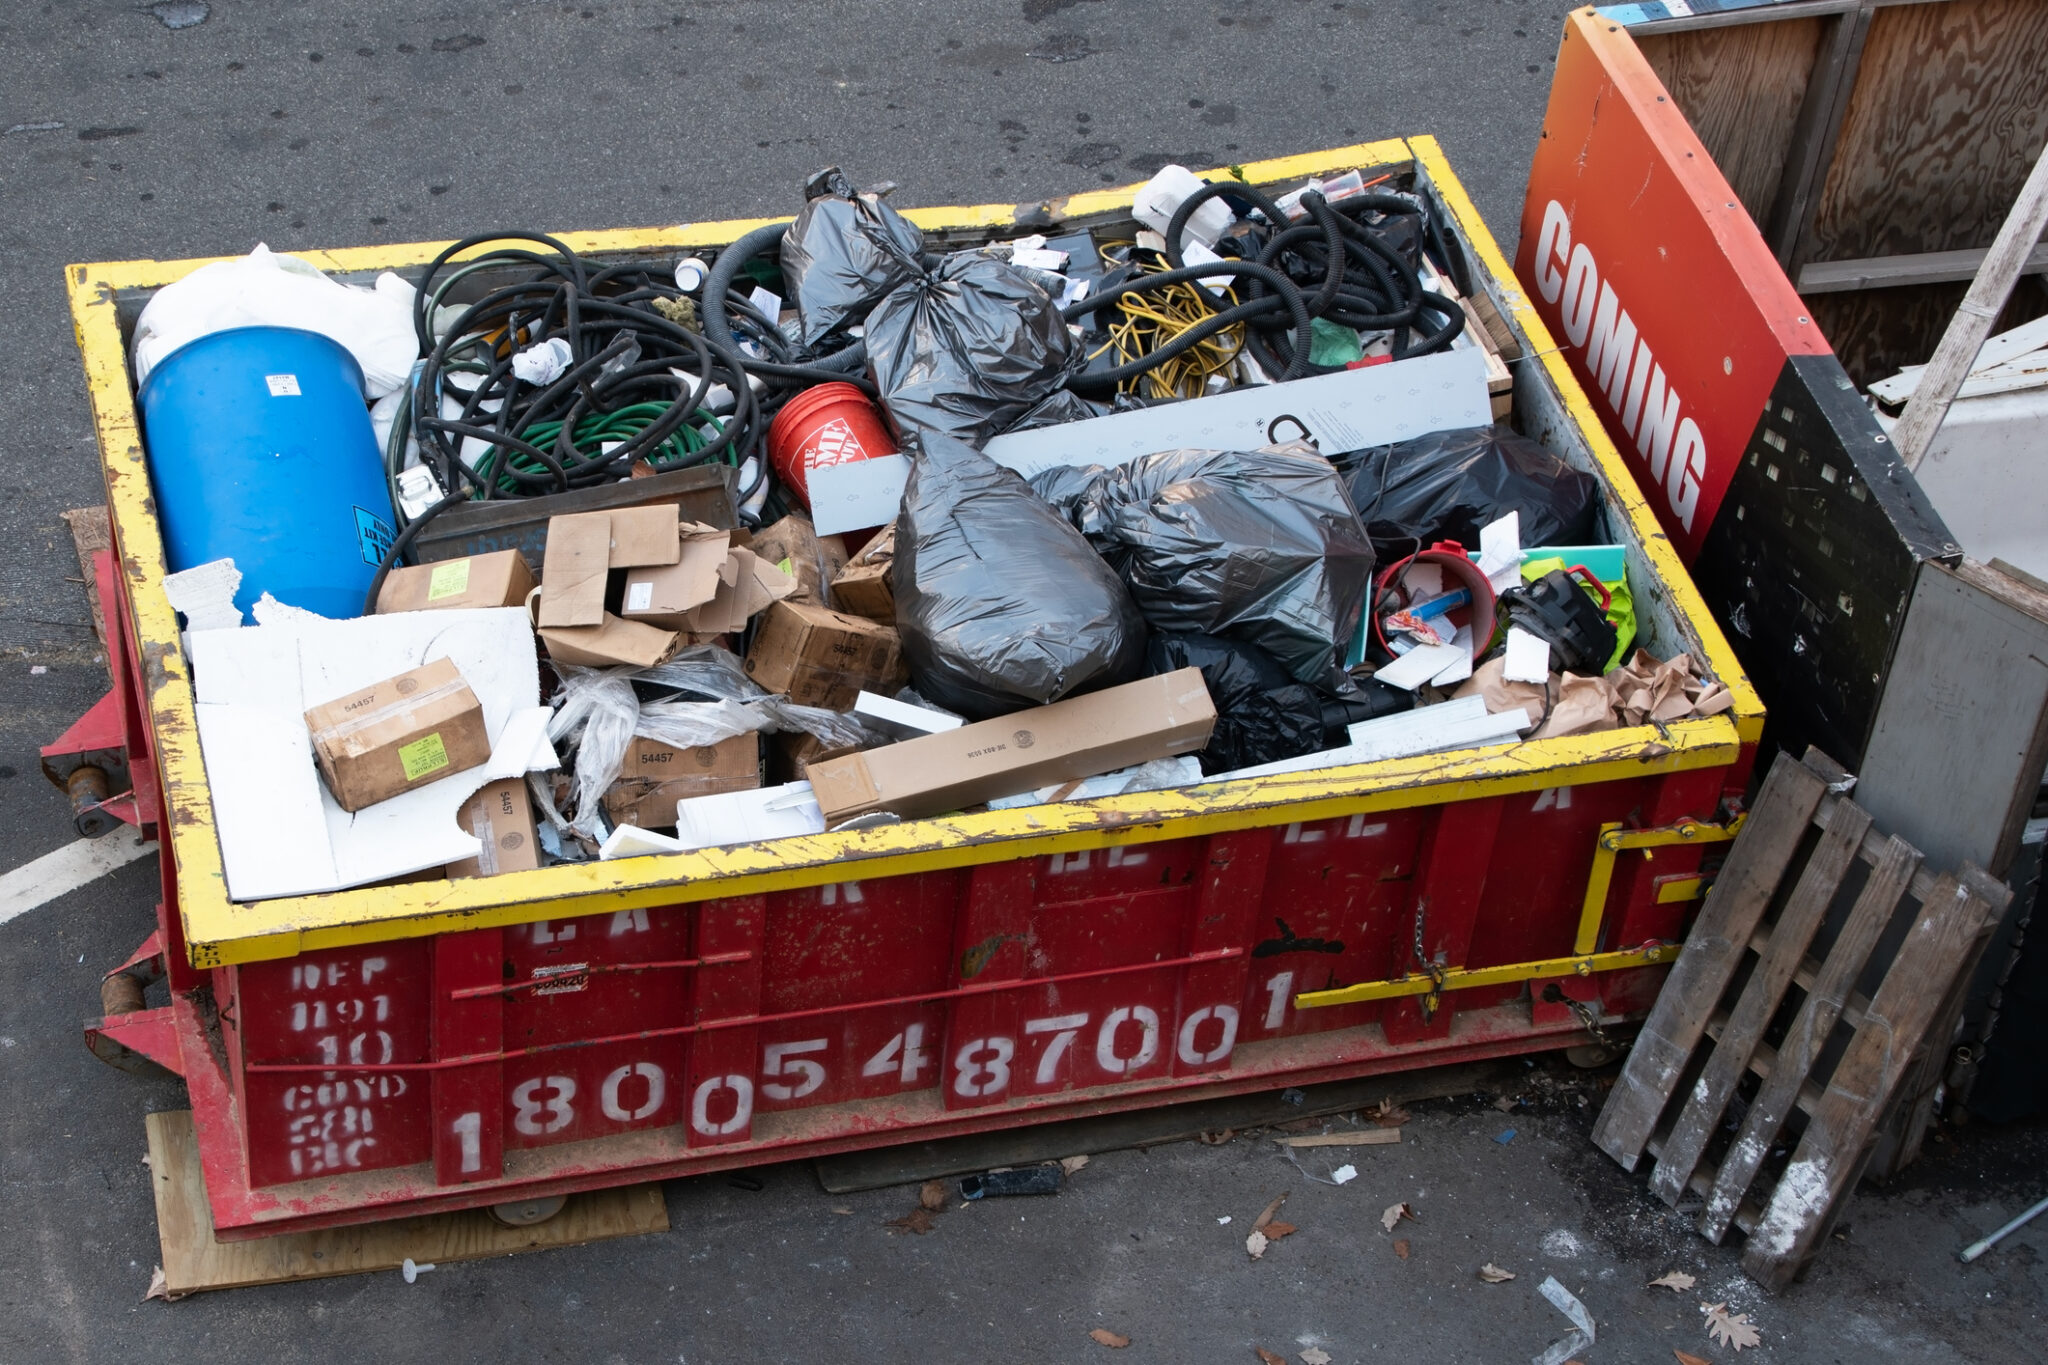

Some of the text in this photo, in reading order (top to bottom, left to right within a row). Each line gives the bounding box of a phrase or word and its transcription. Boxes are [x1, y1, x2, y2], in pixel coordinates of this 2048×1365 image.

[1535, 199, 1706, 534] COMING
[344, 695, 374, 713] 54457
[641, 752, 674, 764] 54457
[500, 791, 513, 815] 54457
[291, 995, 389, 1031] 1191
